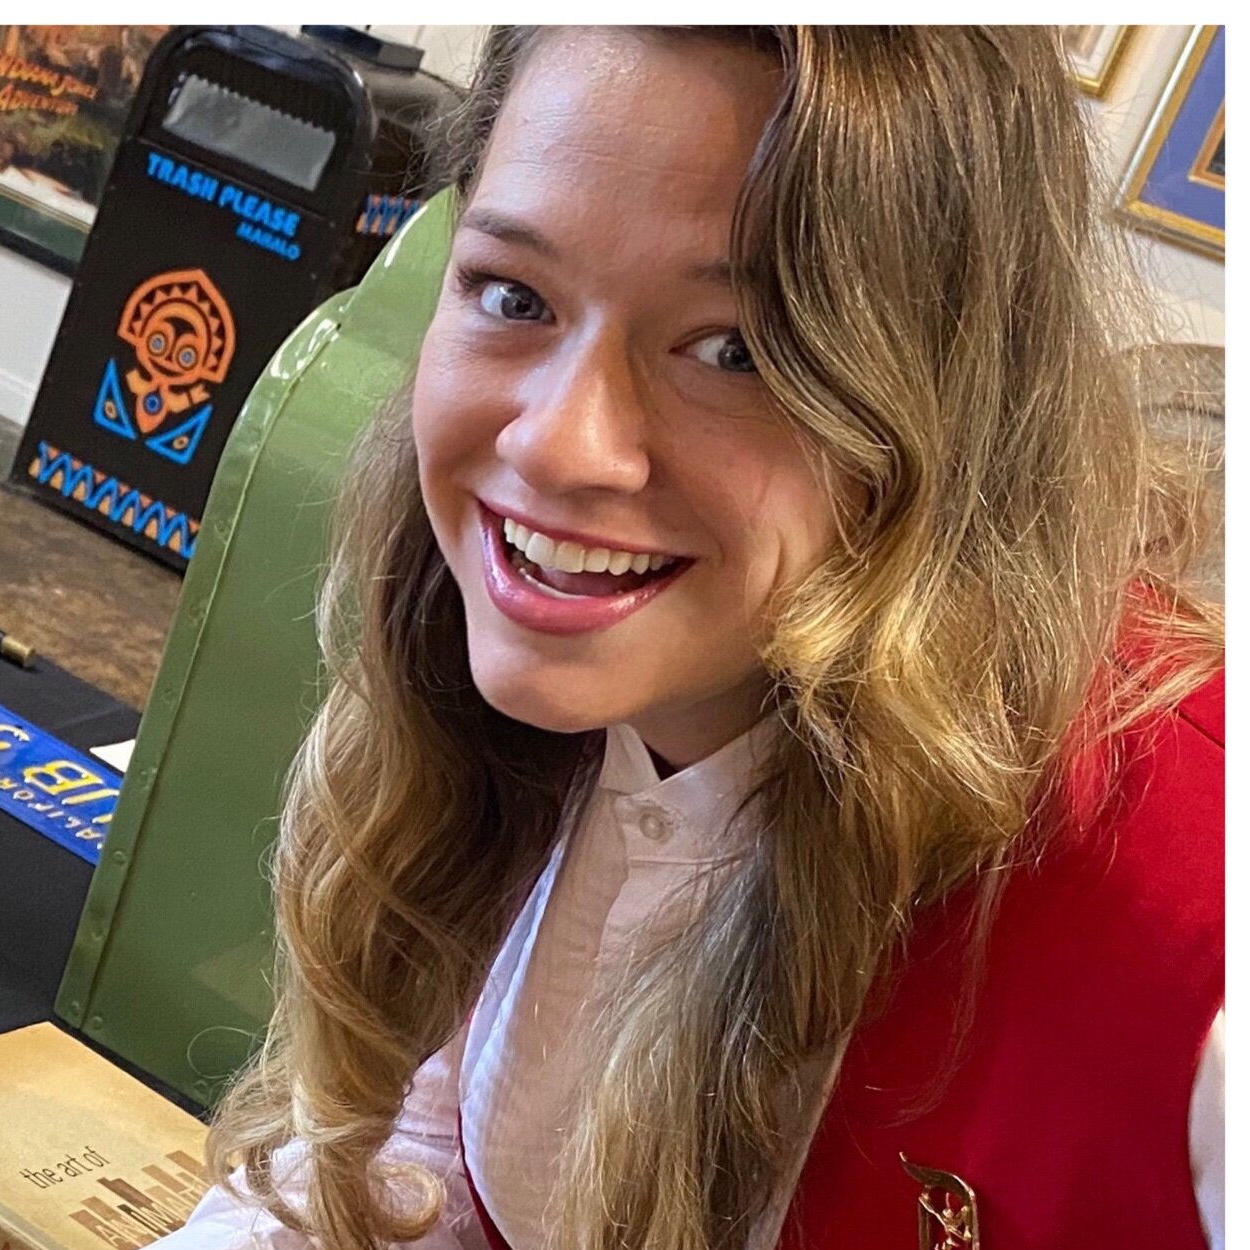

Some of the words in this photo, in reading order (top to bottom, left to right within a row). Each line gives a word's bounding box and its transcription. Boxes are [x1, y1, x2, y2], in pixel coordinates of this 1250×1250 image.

[147, 152, 219, 201] TRASH
[218, 185, 300, 237] PLEASE
[19, 1168, 63, 1189] the
[57, 1154, 93, 1178] art
[83, 1145, 110, 1169] of
